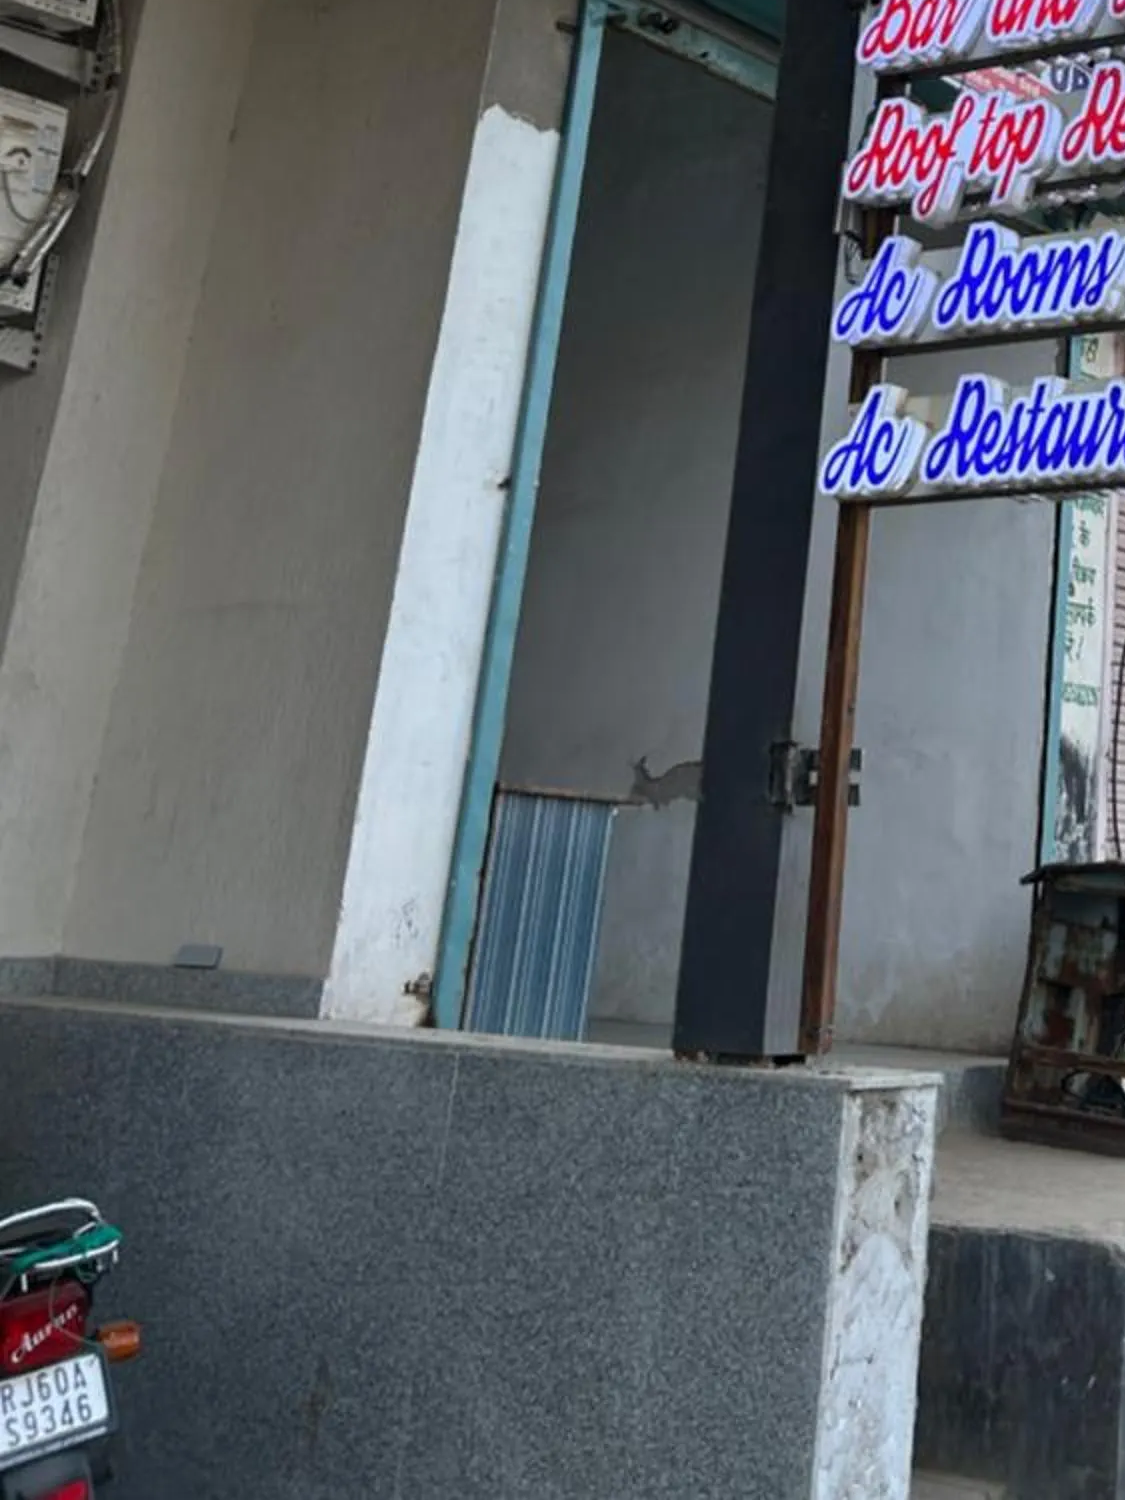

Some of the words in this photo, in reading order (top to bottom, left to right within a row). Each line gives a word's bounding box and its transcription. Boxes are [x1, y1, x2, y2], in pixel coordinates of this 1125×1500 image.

[846, 94, 977, 218] Roof
[967, 94, 1048, 196] top
[834, 236, 914, 338] Ac
[936, 224, 1125, 327] Rooms
[822, 389, 907, 492] Ac
